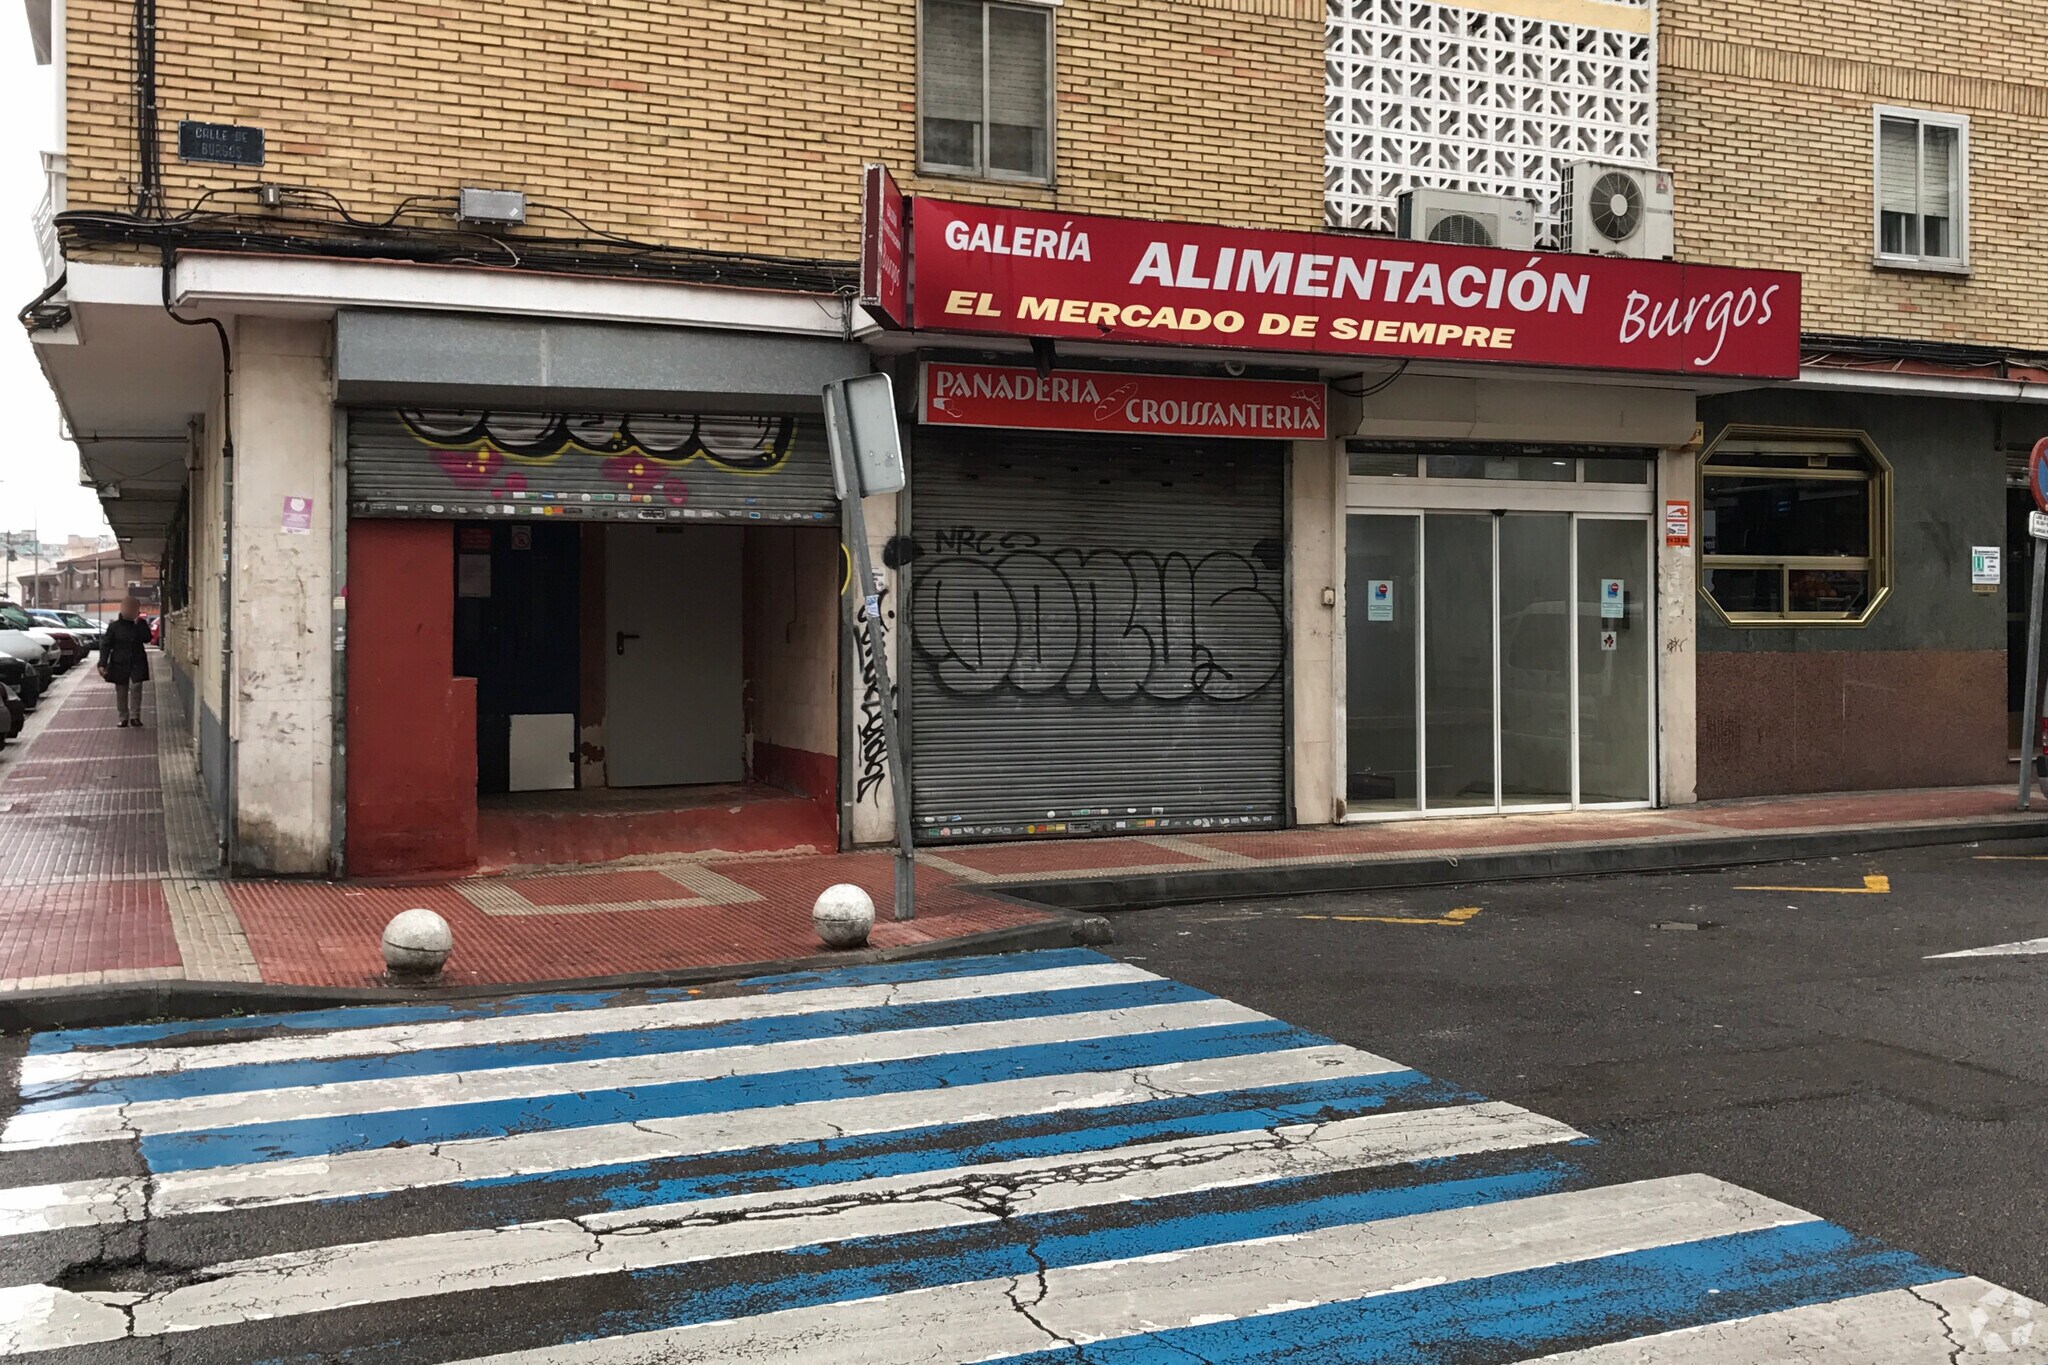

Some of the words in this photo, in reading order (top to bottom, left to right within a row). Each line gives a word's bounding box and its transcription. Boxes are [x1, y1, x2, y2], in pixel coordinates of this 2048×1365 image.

[195, 127, 228, 141] CALLE
[235, 131, 249, 143] DE
[201, 143, 242, 159] BURGOS
[944, 220, 1091, 262] GALERÍA
[1128, 241, 1590, 315] ALIMENTACIÓN
[944, 290, 1002, 317] EL
[1016, 296, 1245, 333] MERCADO
[1257, 312, 1320, 338] DE
[1329, 317, 1516, 349] SIEMPRE
[1619, 284, 1780, 366] Burgos
[936, 371, 1101, 404] PANADERIA
[1125, 399, 1321, 430] CROISSANTERIA
